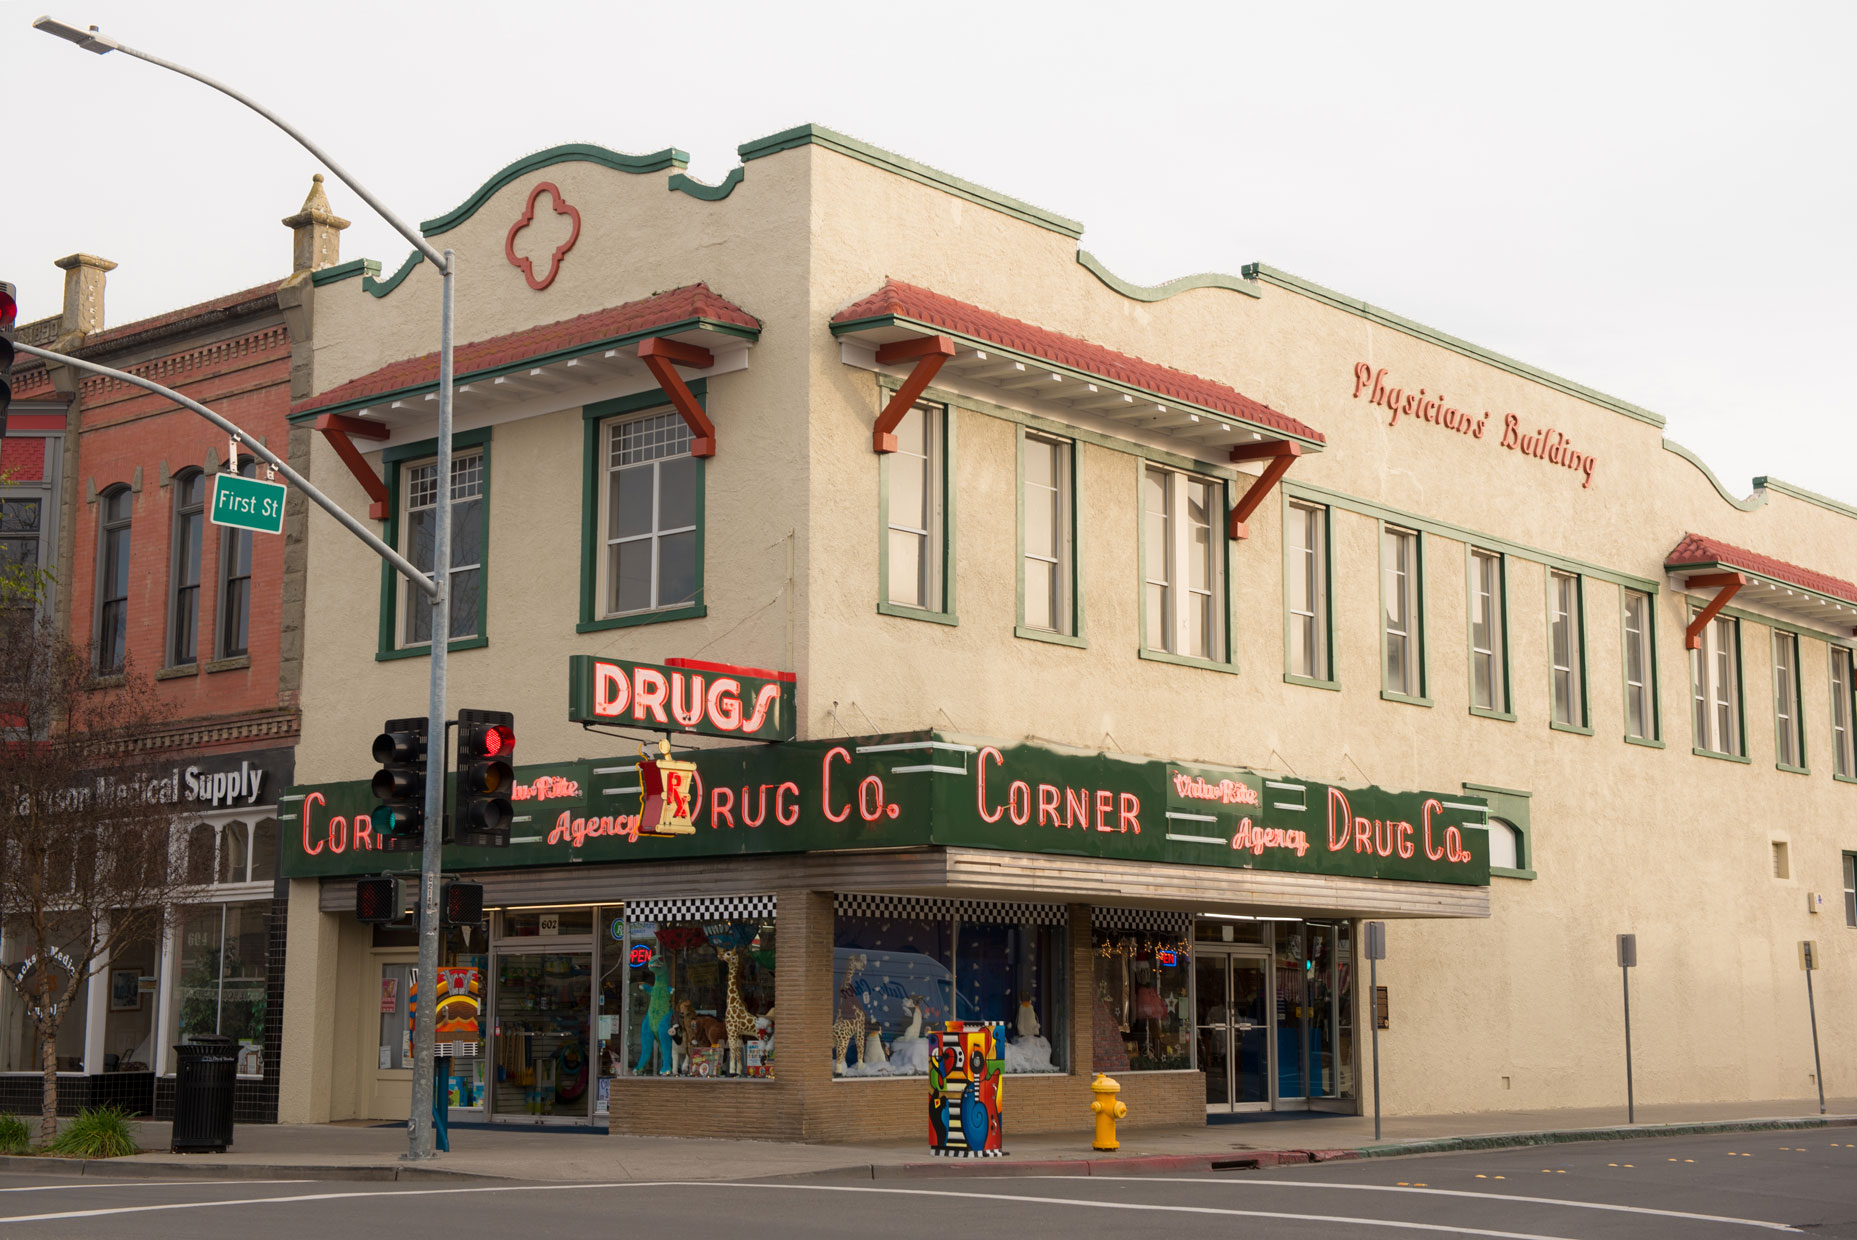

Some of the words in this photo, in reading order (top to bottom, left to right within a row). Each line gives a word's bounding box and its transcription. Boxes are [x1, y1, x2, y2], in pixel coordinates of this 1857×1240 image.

[1353, 361, 1491, 439] Physicians'
[1501, 412, 1598, 489] Building
[219, 490, 256, 513] First
[262, 498, 278, 517] St
[593, 661, 781, 733] DRUGS
[184, 760, 263, 807] Supply
[302, 792, 383, 855] COR
[547, 809, 640, 848] Agency
[1231, 817, 1310, 857] Agency
[188, 931, 208, 946] 604
[541, 919, 557, 930] 602
[630, 949, 653, 963] PEN
[1159, 952, 1175, 965] PEN
